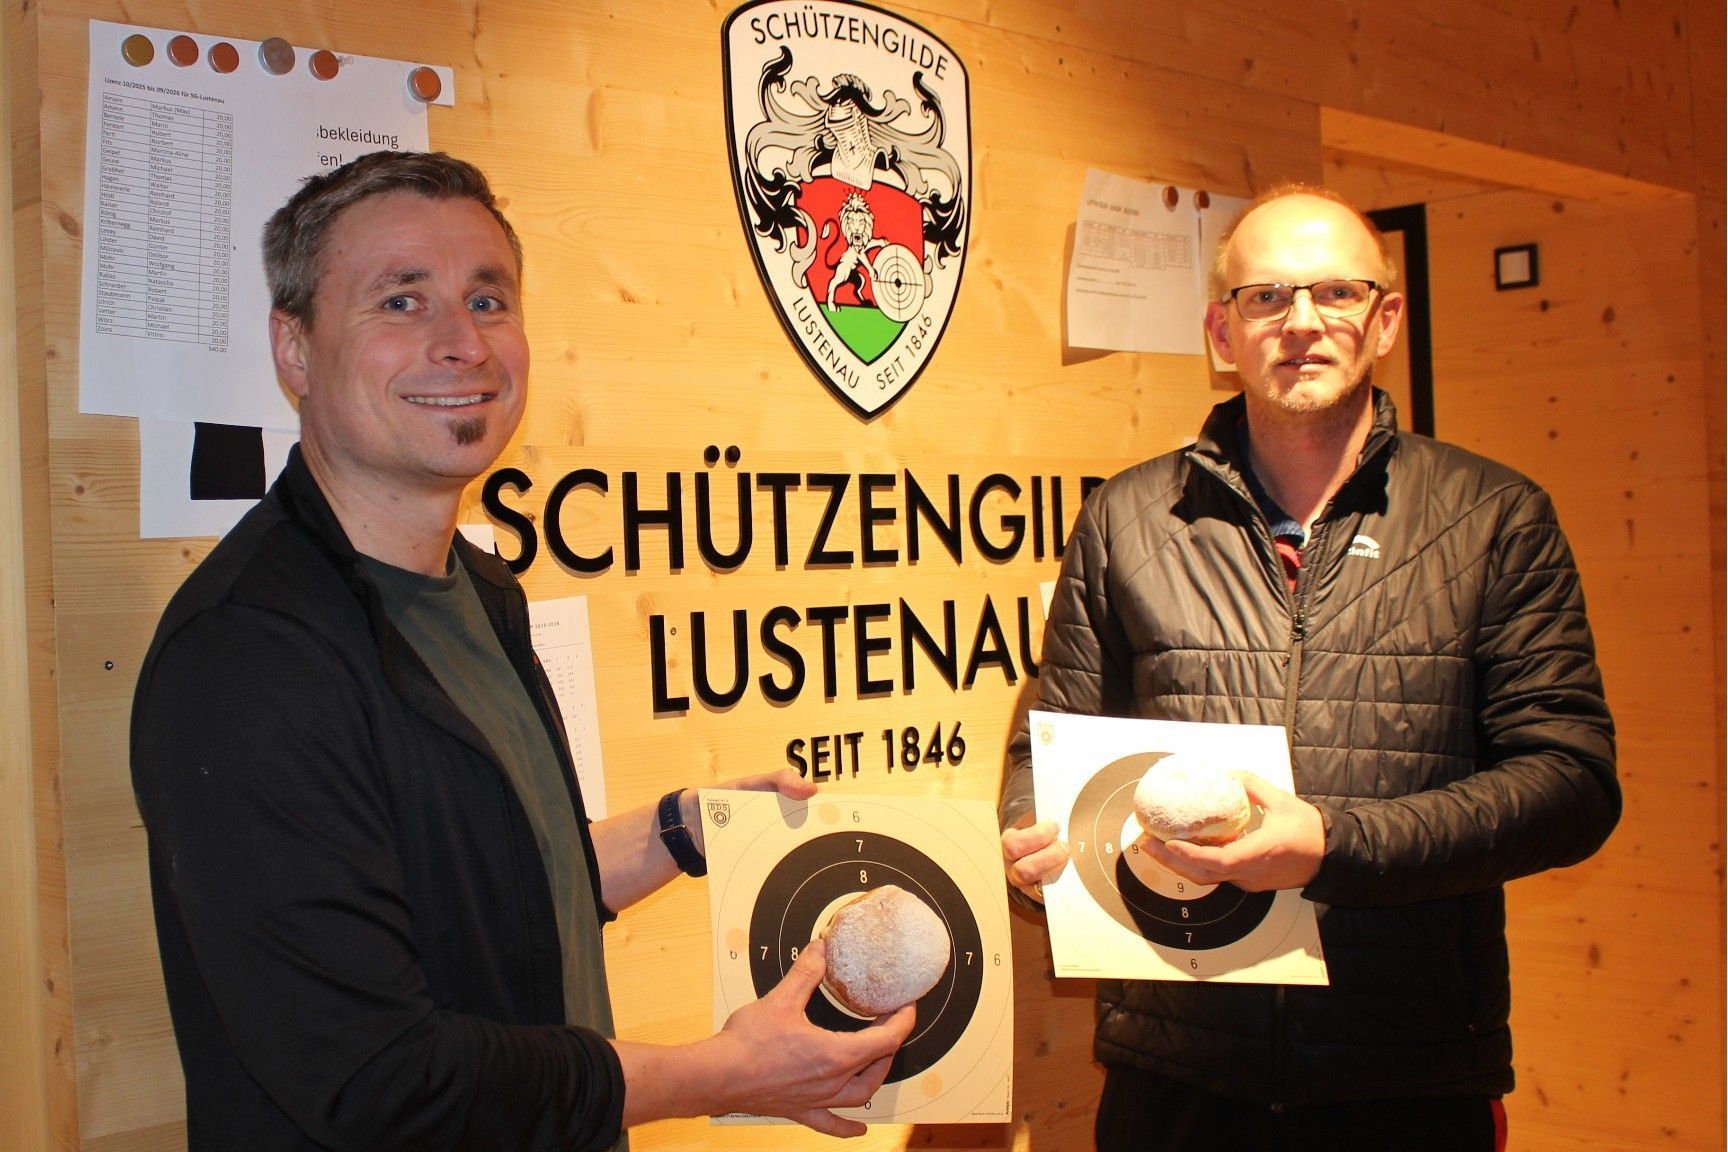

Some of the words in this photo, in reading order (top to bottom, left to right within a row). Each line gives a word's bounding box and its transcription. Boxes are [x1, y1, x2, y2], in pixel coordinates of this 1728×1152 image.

[751, 6, 948, 80] SCHÜTZENGILDE
[104, 77, 120, 85] Lizenz
[122, 78, 145, 90] 10/2025
[156, 86, 180, 96] 09/2026
[191, 92, 224, 104] SG-Lustenau
[317, 125, 399, 149] bekleidung
[318, 152, 343, 166] en!
[792, 297, 860, 389] LUSTENAU
[876, 356, 907, 390] SEIT
[905, 314, 932, 358] 1846
[482, 445, 1107, 575] SCHÜTZENGIL
[785, 732, 864, 780] SEIT
[884, 721, 966, 768] 1846
[853, 811, 860, 823] 6
[856, 840, 864, 853] 7
[1078, 842, 1086, 853] 7
[1105, 842, 1113, 854] 8
[1132, 844, 1139, 854] 9
[859, 871, 868, 884] 8
[1176, 882, 1184, 893] 9
[1181, 907, 1189, 919] 8
[1185, 932, 1193, 943] 7
[760, 946, 768, 960] 7
[791, 947, 798, 961] 8
[965, 952, 973, 965] 7
[994, 954, 1001, 966] 6
[1190, 958, 1198, 969] 6
